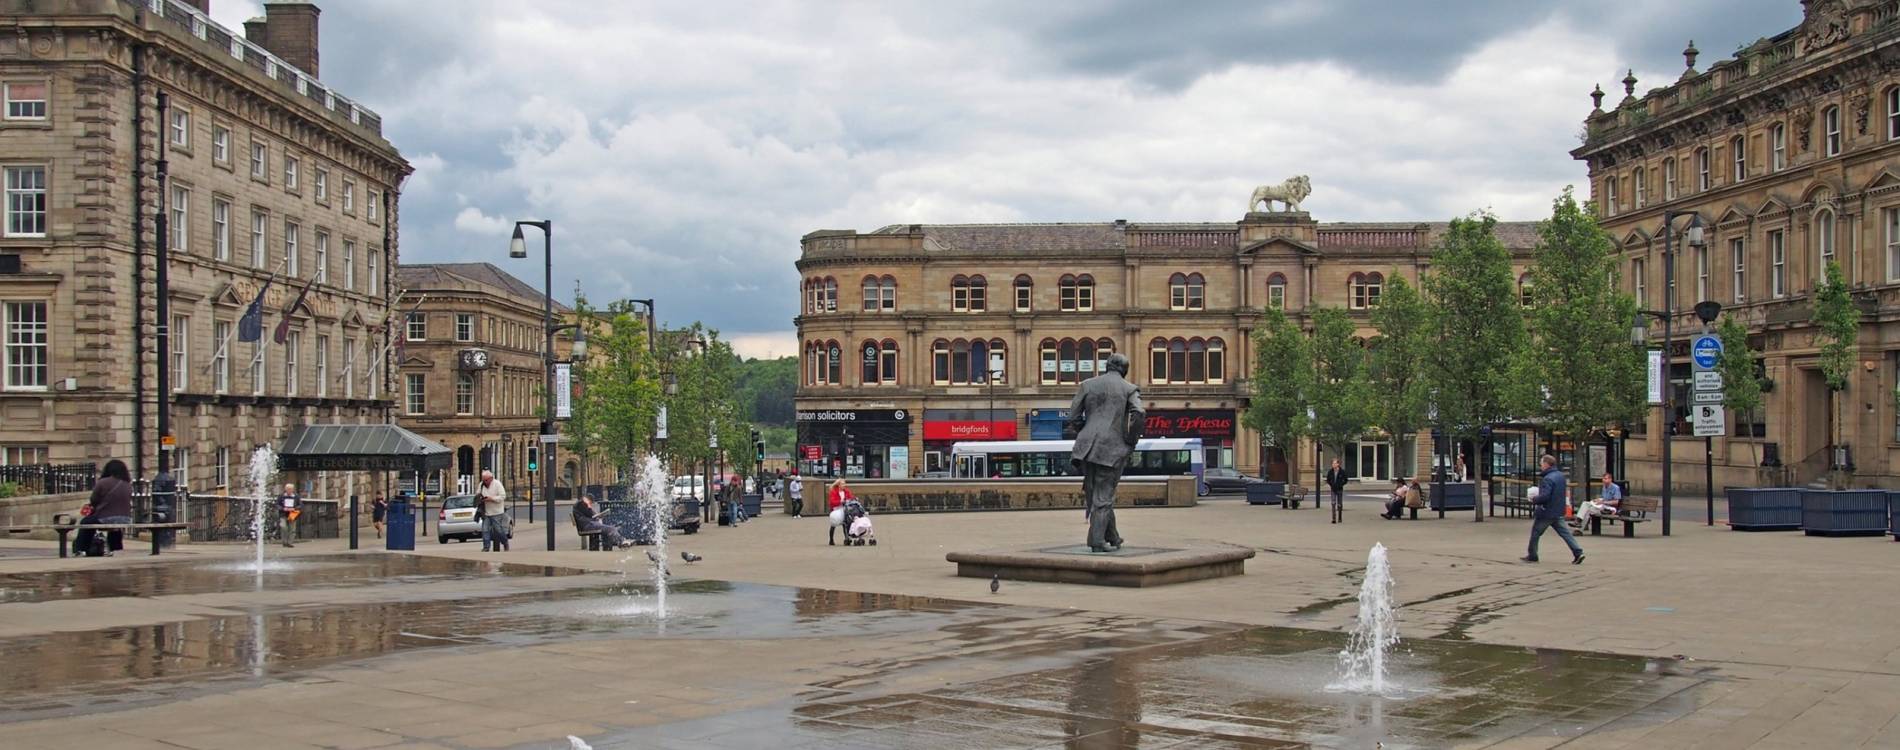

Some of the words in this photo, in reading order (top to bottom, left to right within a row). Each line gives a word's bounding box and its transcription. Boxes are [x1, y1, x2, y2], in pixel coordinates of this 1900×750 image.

[817, 411, 856, 420] solicitors
[1145, 416, 1171, 428] The
[1176, 416, 1231, 432] Ephesus
[951, 425, 989, 435] bridgfords
[297, 459, 316, 468] THE
[322, 458, 369, 469] GEORGE
[371, 457, 412, 469] HOTEL
